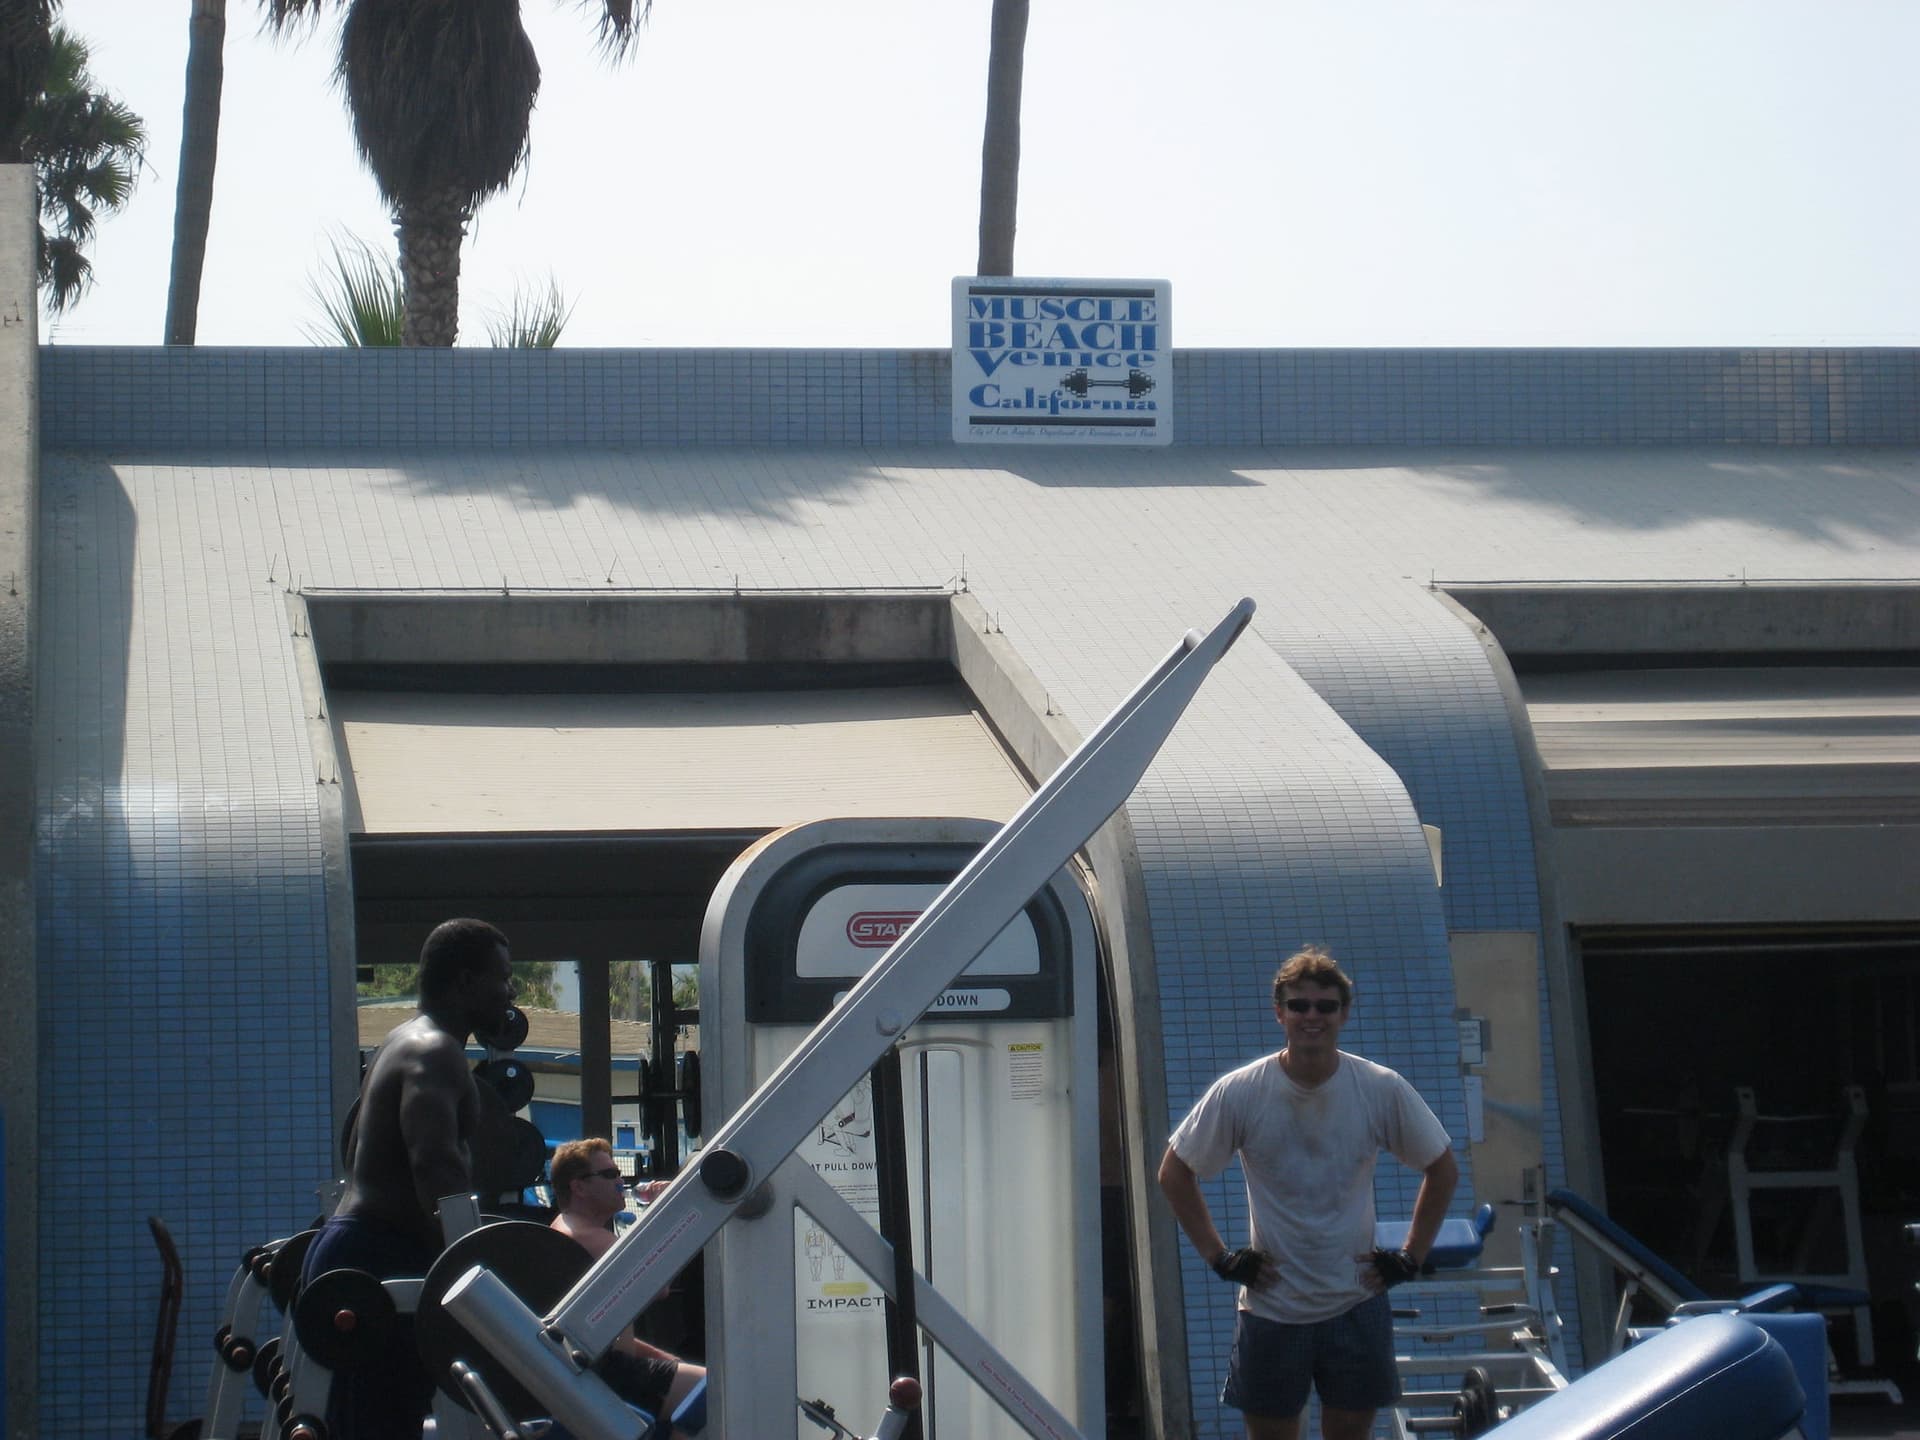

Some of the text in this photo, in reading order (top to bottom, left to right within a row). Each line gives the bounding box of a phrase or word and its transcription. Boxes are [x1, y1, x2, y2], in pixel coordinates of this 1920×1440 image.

[968, 297, 1157, 321] MUSCLE
[968, 321, 1159, 351] BEACH
[968, 350, 1156, 377] Venice
[968, 383, 1157, 415] California
[936, 995, 978, 1006] DOWN
[825, 1163, 848, 1171] PULL
[807, 1297, 885, 1309] IMPACT
